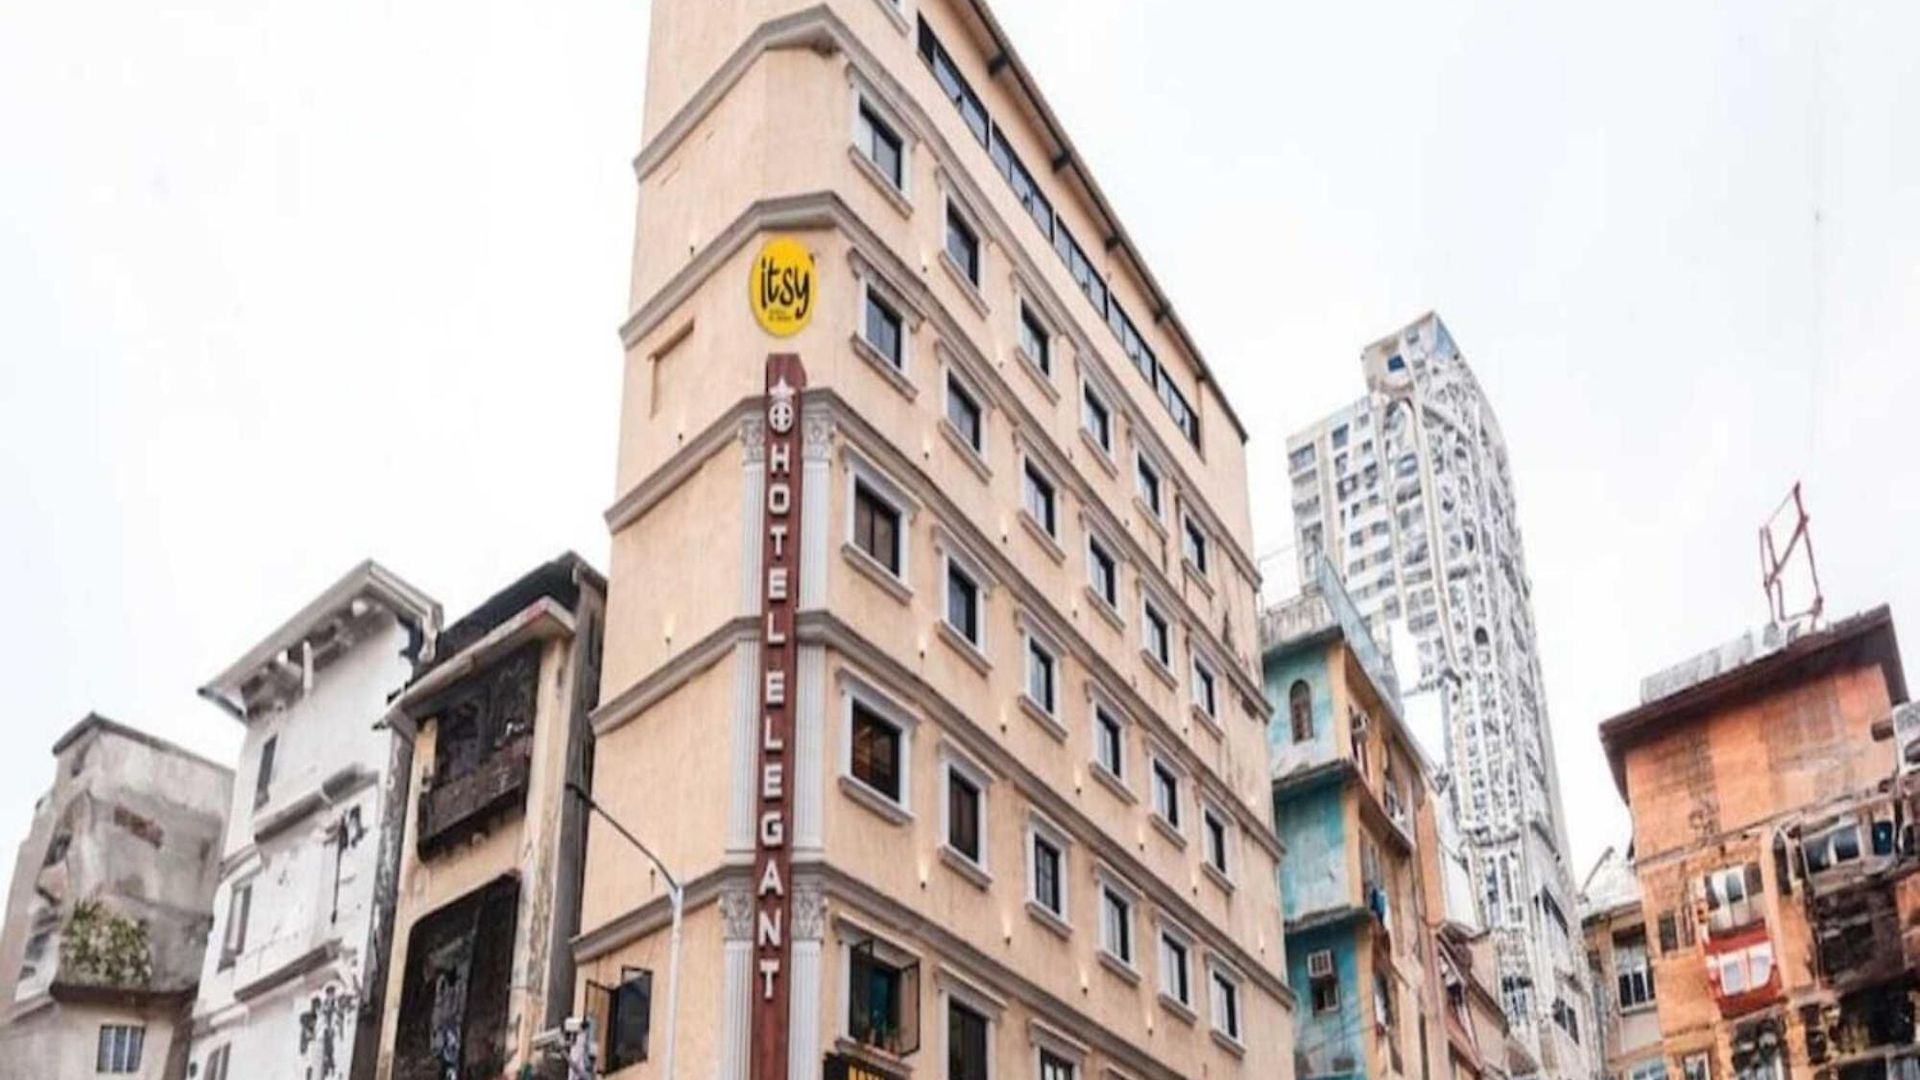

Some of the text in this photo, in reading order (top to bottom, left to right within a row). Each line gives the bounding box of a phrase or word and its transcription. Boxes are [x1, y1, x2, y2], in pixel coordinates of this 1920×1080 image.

[761, 256, 809, 320] itsy
[758, 444, 790, 999] HOTEL ELEGANT
